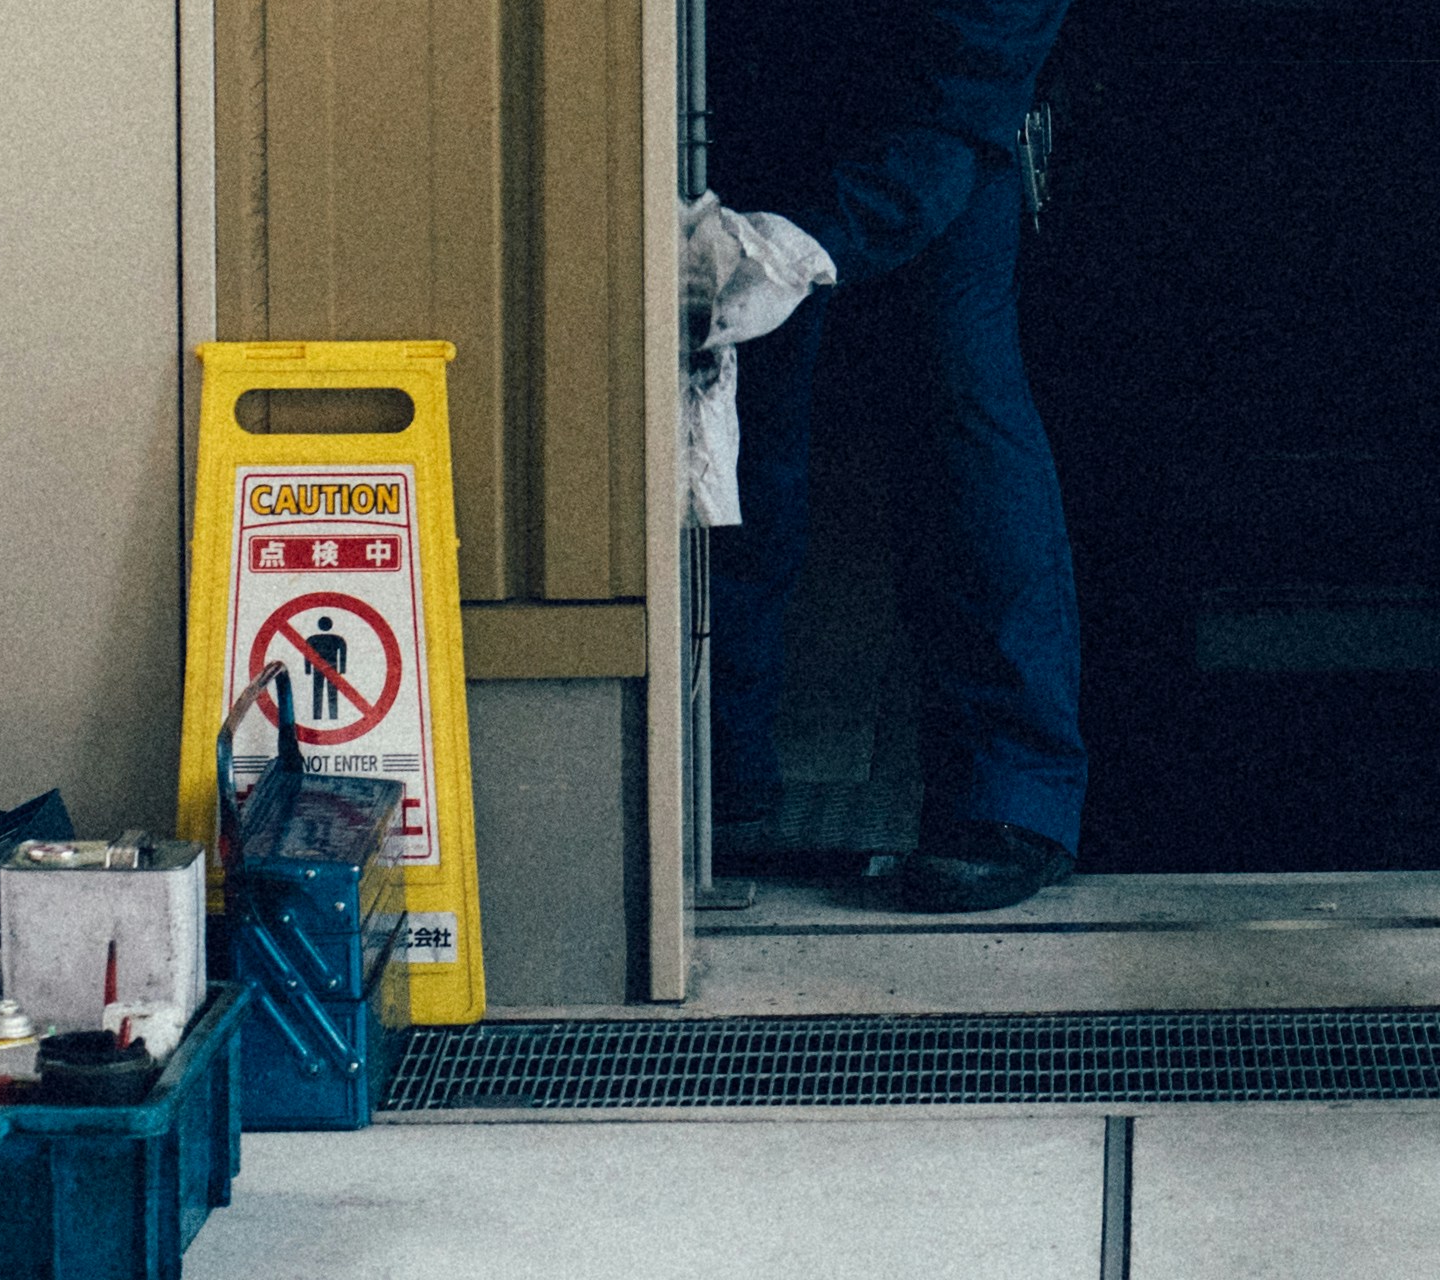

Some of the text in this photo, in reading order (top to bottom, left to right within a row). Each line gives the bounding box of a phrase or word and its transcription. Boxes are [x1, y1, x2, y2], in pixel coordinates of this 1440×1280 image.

[250, 481, 402, 517] CAUTION
[258, 538, 393, 568] 点検中
[301, 755, 378, 773] NOT ENTER
